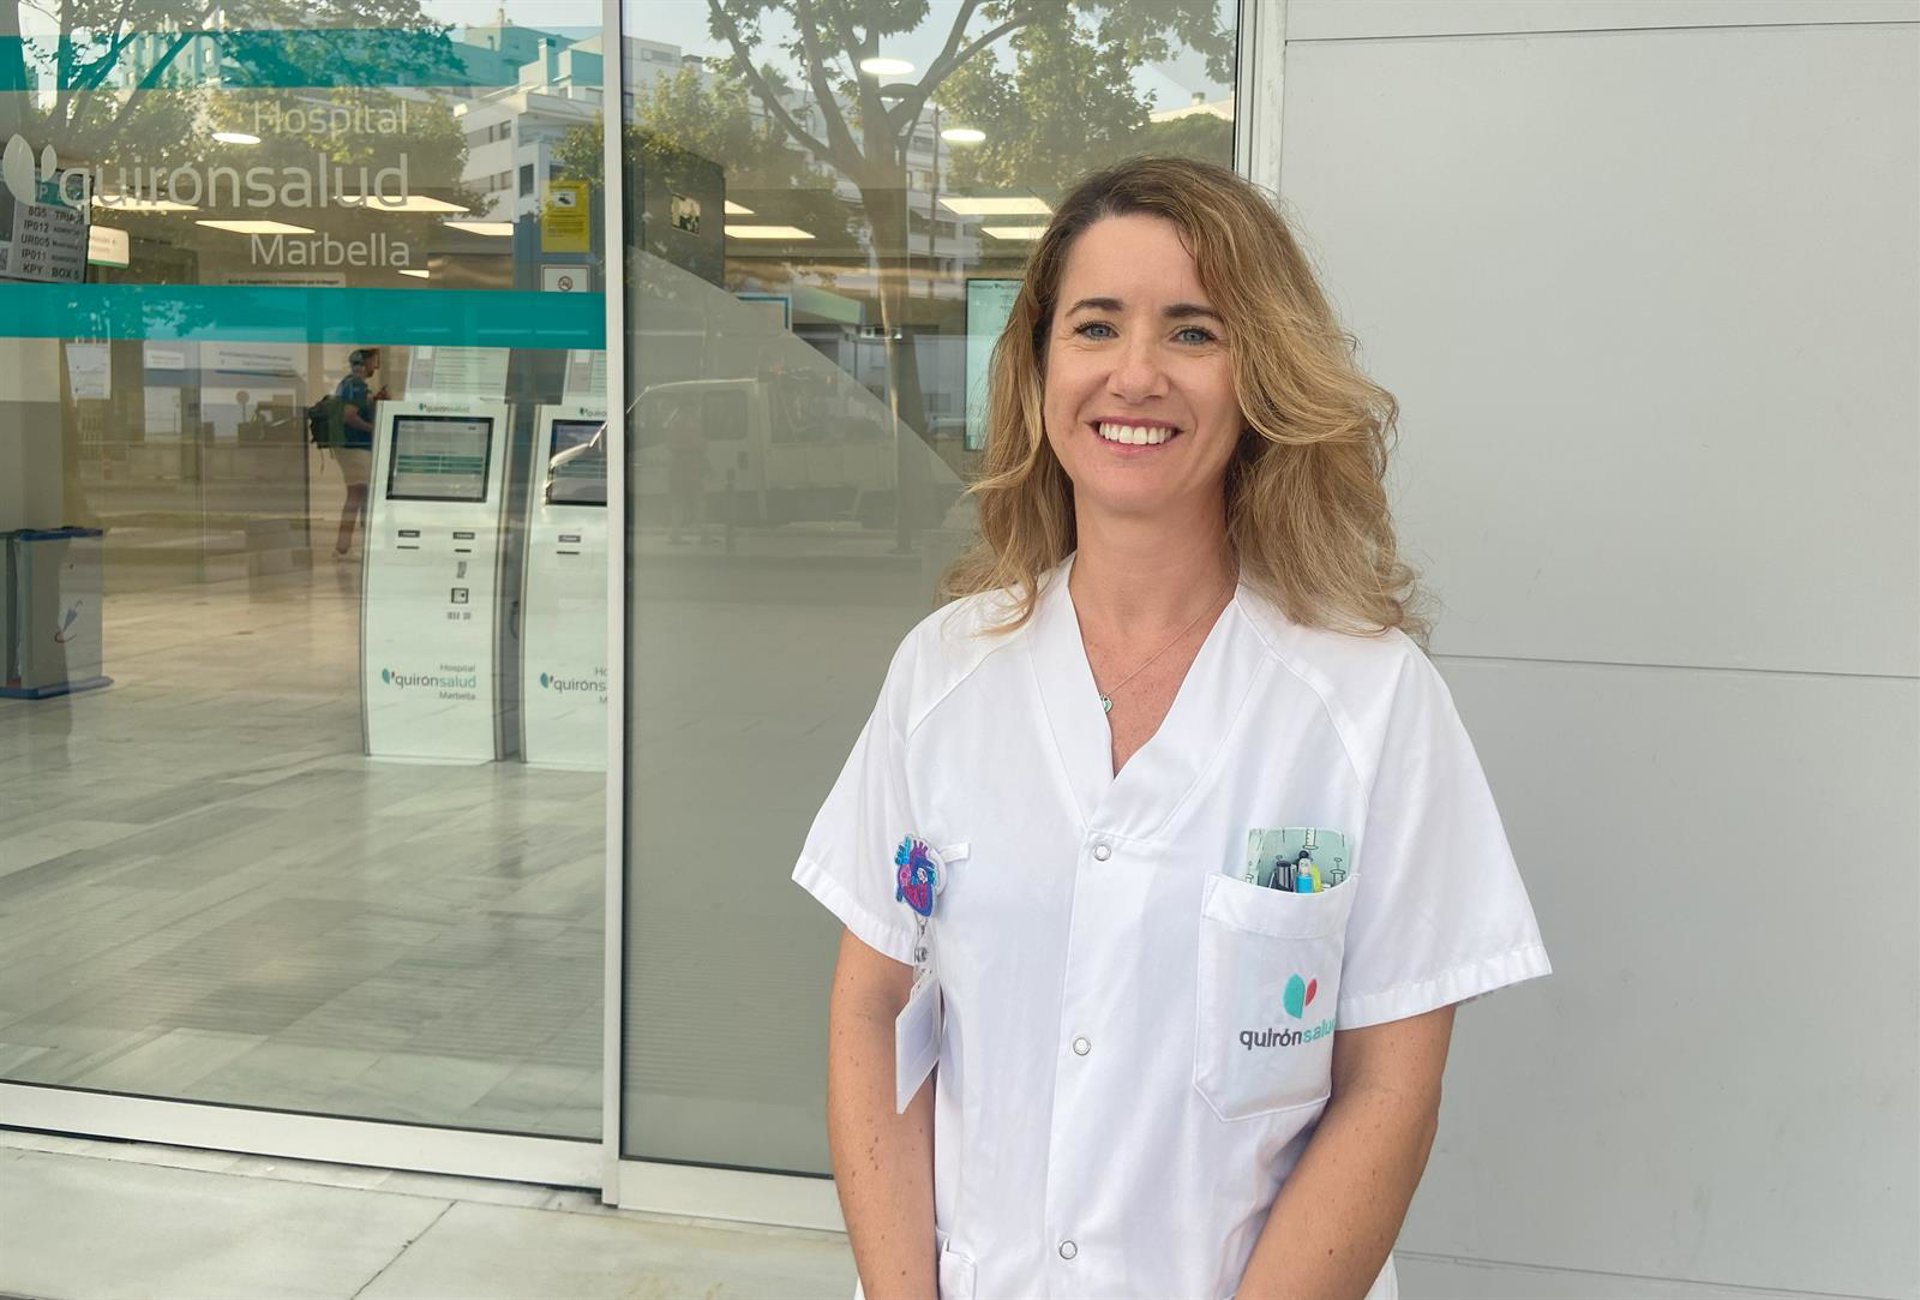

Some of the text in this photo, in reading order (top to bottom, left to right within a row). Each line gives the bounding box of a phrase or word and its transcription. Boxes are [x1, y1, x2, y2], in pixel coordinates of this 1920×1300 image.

[254, 100, 408, 141] Hospital
[59, 152, 409, 226] quirónsalud
[250, 232, 410, 266] Marbella
[395, 674, 477, 689] quirónsalud
[1239, 1018, 1335, 1051] quirónsalu
